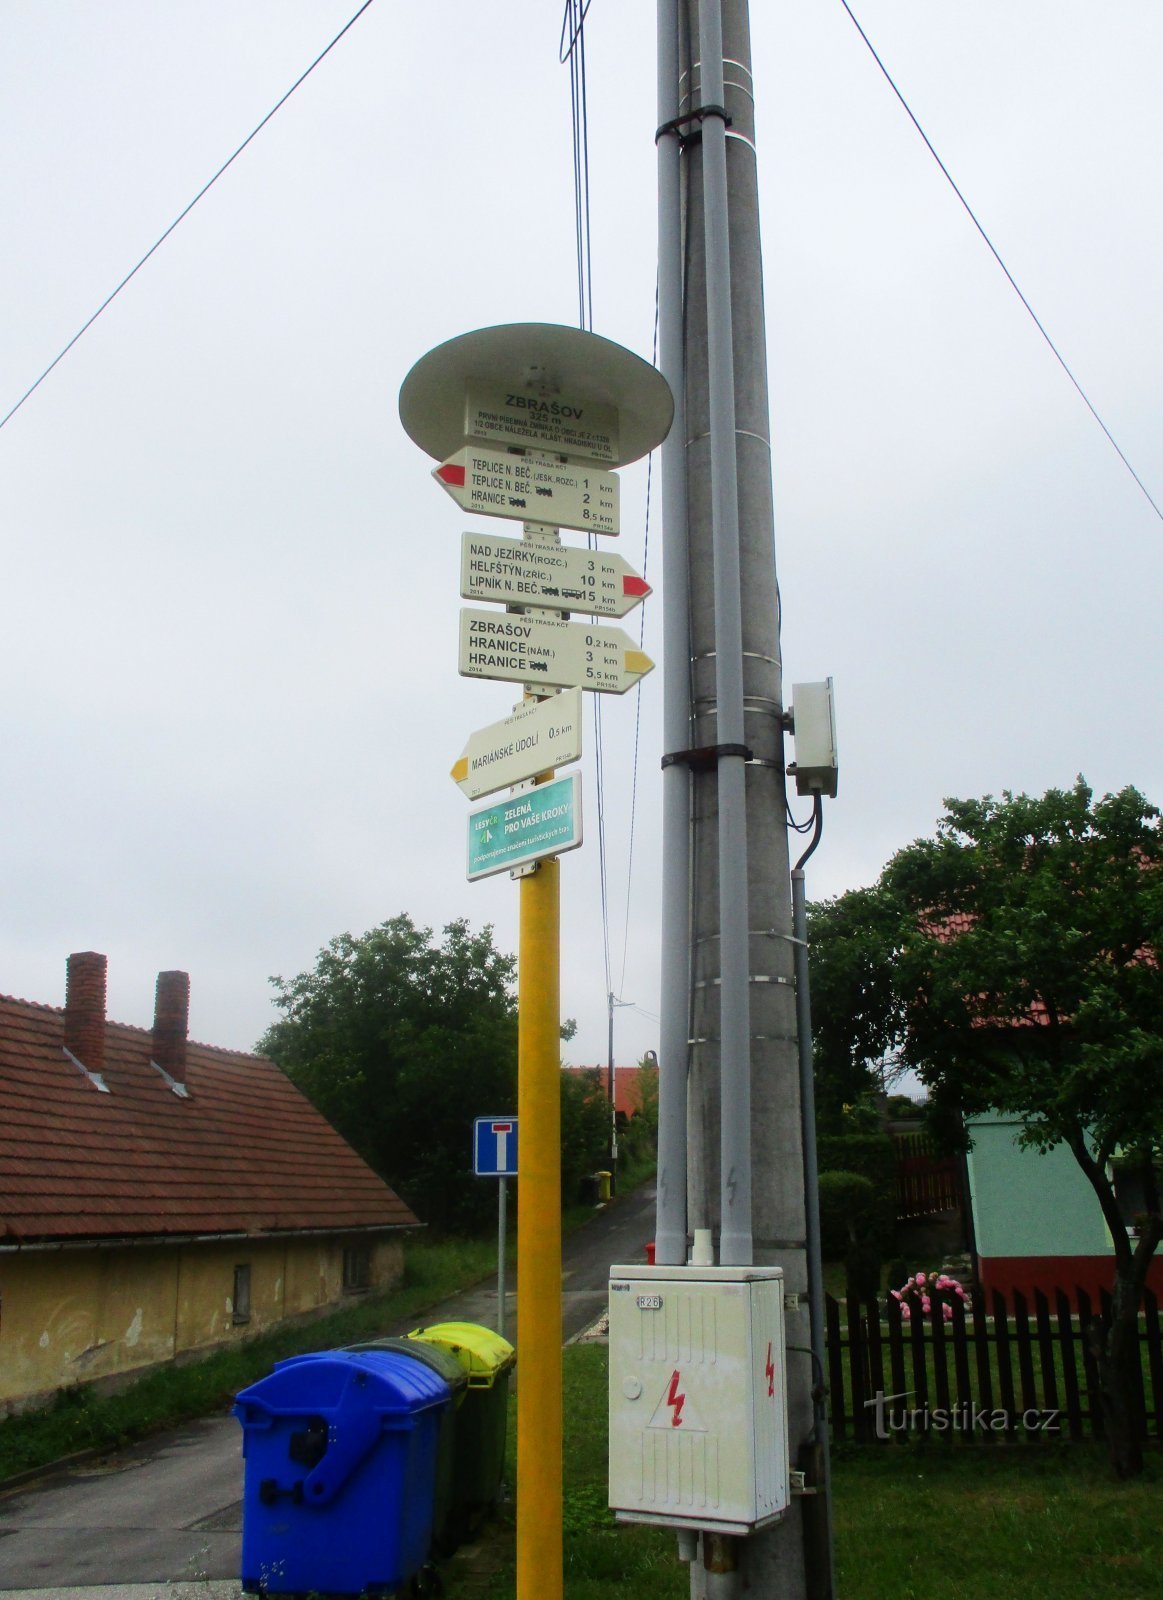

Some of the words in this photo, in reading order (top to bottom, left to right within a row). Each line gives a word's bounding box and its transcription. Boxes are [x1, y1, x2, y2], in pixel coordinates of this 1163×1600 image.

[505, 394, 584, 420] ZBRAŠOV
[530, 411, 548, 421] 325
[551, 417, 562, 425] m
[484, 421, 504, 431] OBCE
[472, 458, 504, 473] TEPLICE
[505, 466, 514, 476] N.
[515, 465, 533, 480] BEČ.
[583, 479, 589, 489] 1
[600, 484, 613, 493] km
[472, 474, 504, 489] TEPLICE
[505, 481, 513, 491] N.
[514, 480, 532, 495] BEČ.
[583, 494, 590, 504] 2
[600, 499, 613, 508] km
[471, 490, 506, 505] HRANICE
[600, 514, 613, 523] km
[470, 543, 492, 557] NAD
[587, 560, 595, 571] 3
[601, 565, 615, 574] km
[470, 560, 522, 576] HELFŠTÝN
[580, 575, 595, 586] 10
[601, 580, 616, 589] km
[469, 575, 502, 590] LIPNÍK
[504, 580, 514, 591] N.
[517, 581, 540, 595] BEČ.
[581, 590, 596, 602] 15
[601, 596, 616, 604] km
[470, 620, 531, 638] ZBRAŠOV
[603, 641, 618, 649] km
[469, 636, 526, 653] HRANICE
[586, 651, 593, 662] 3
[604, 657, 618, 665] km
[469, 653, 526, 670] HRANICE
[604, 672, 618, 681] km
[472, 743, 514, 771] MARIÁNSKÉ
[561, 725, 572, 734] km
[504, 800, 532, 821] ZELENÁ
[504, 821, 520, 835] PRO
[520, 812, 540, 829] VAŠE
[541, 803, 570, 821] KROKY
[527, 829, 558, 846] turistických
[559, 825, 570, 834] tras
